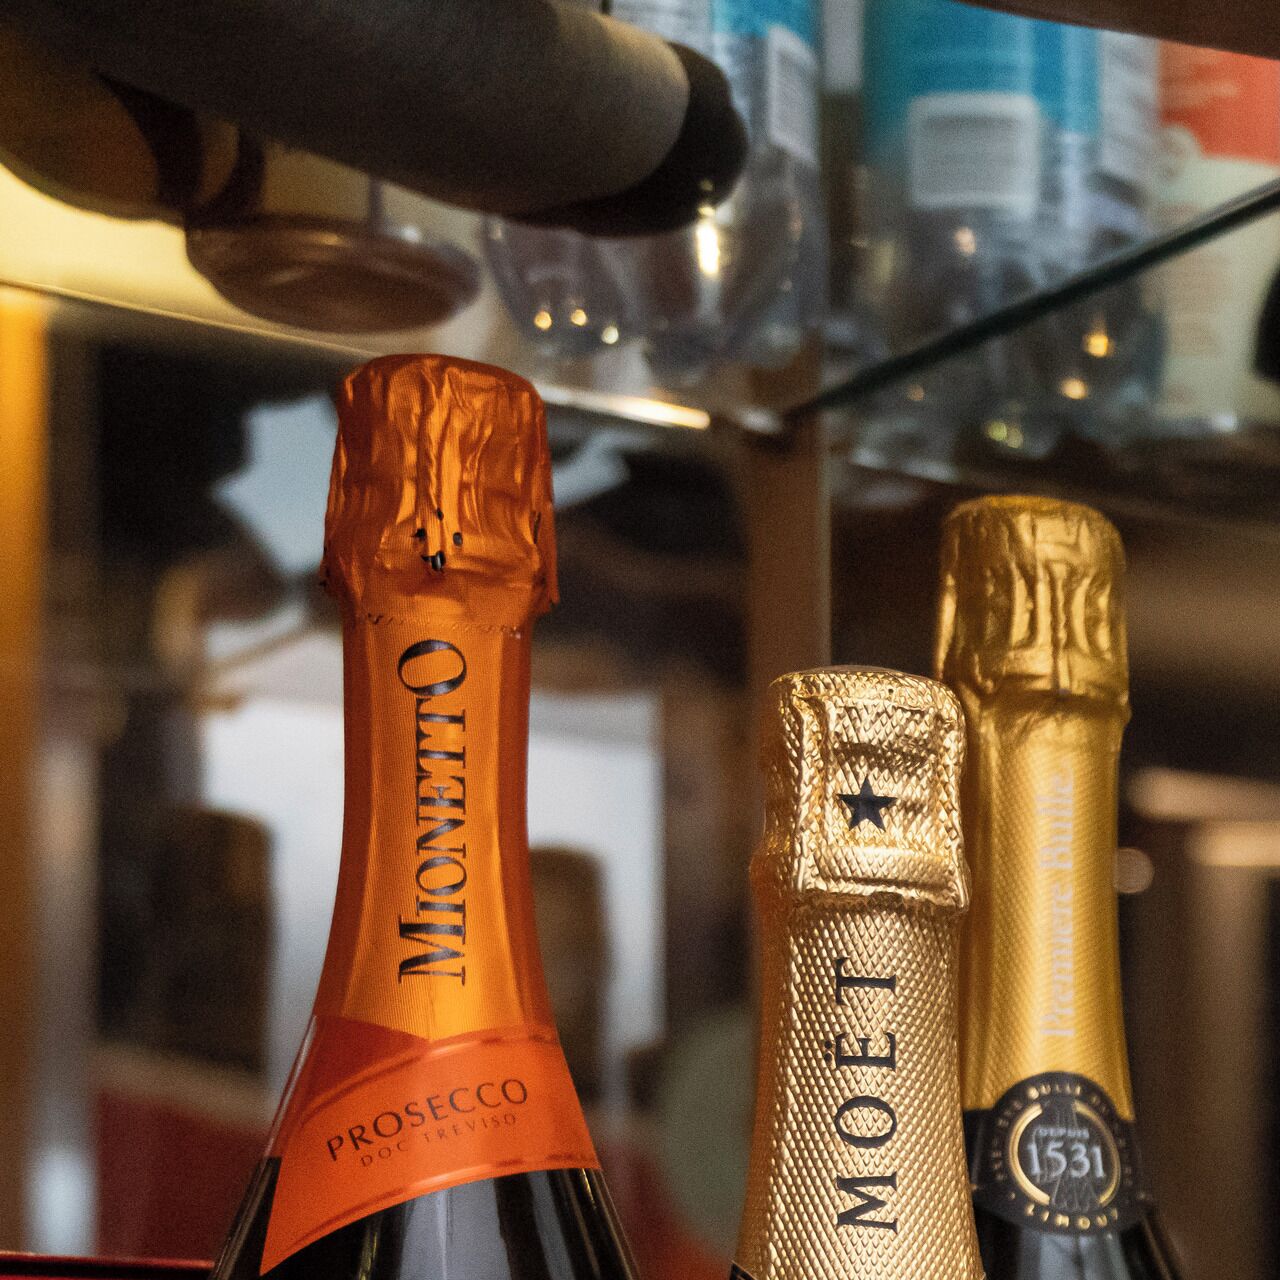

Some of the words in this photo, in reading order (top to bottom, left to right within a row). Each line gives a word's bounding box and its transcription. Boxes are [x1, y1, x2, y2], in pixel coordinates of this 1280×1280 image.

[397, 639, 467, 986] MIONETTO
[326, 1079, 528, 1162] PROSECCO
[824, 958, 898, 1233] MOËT
[360, 1140, 409, 1167] DOC
[424, 1112, 518, 1144] TREVISO
[1027, 1140, 1105, 1179] 1531
